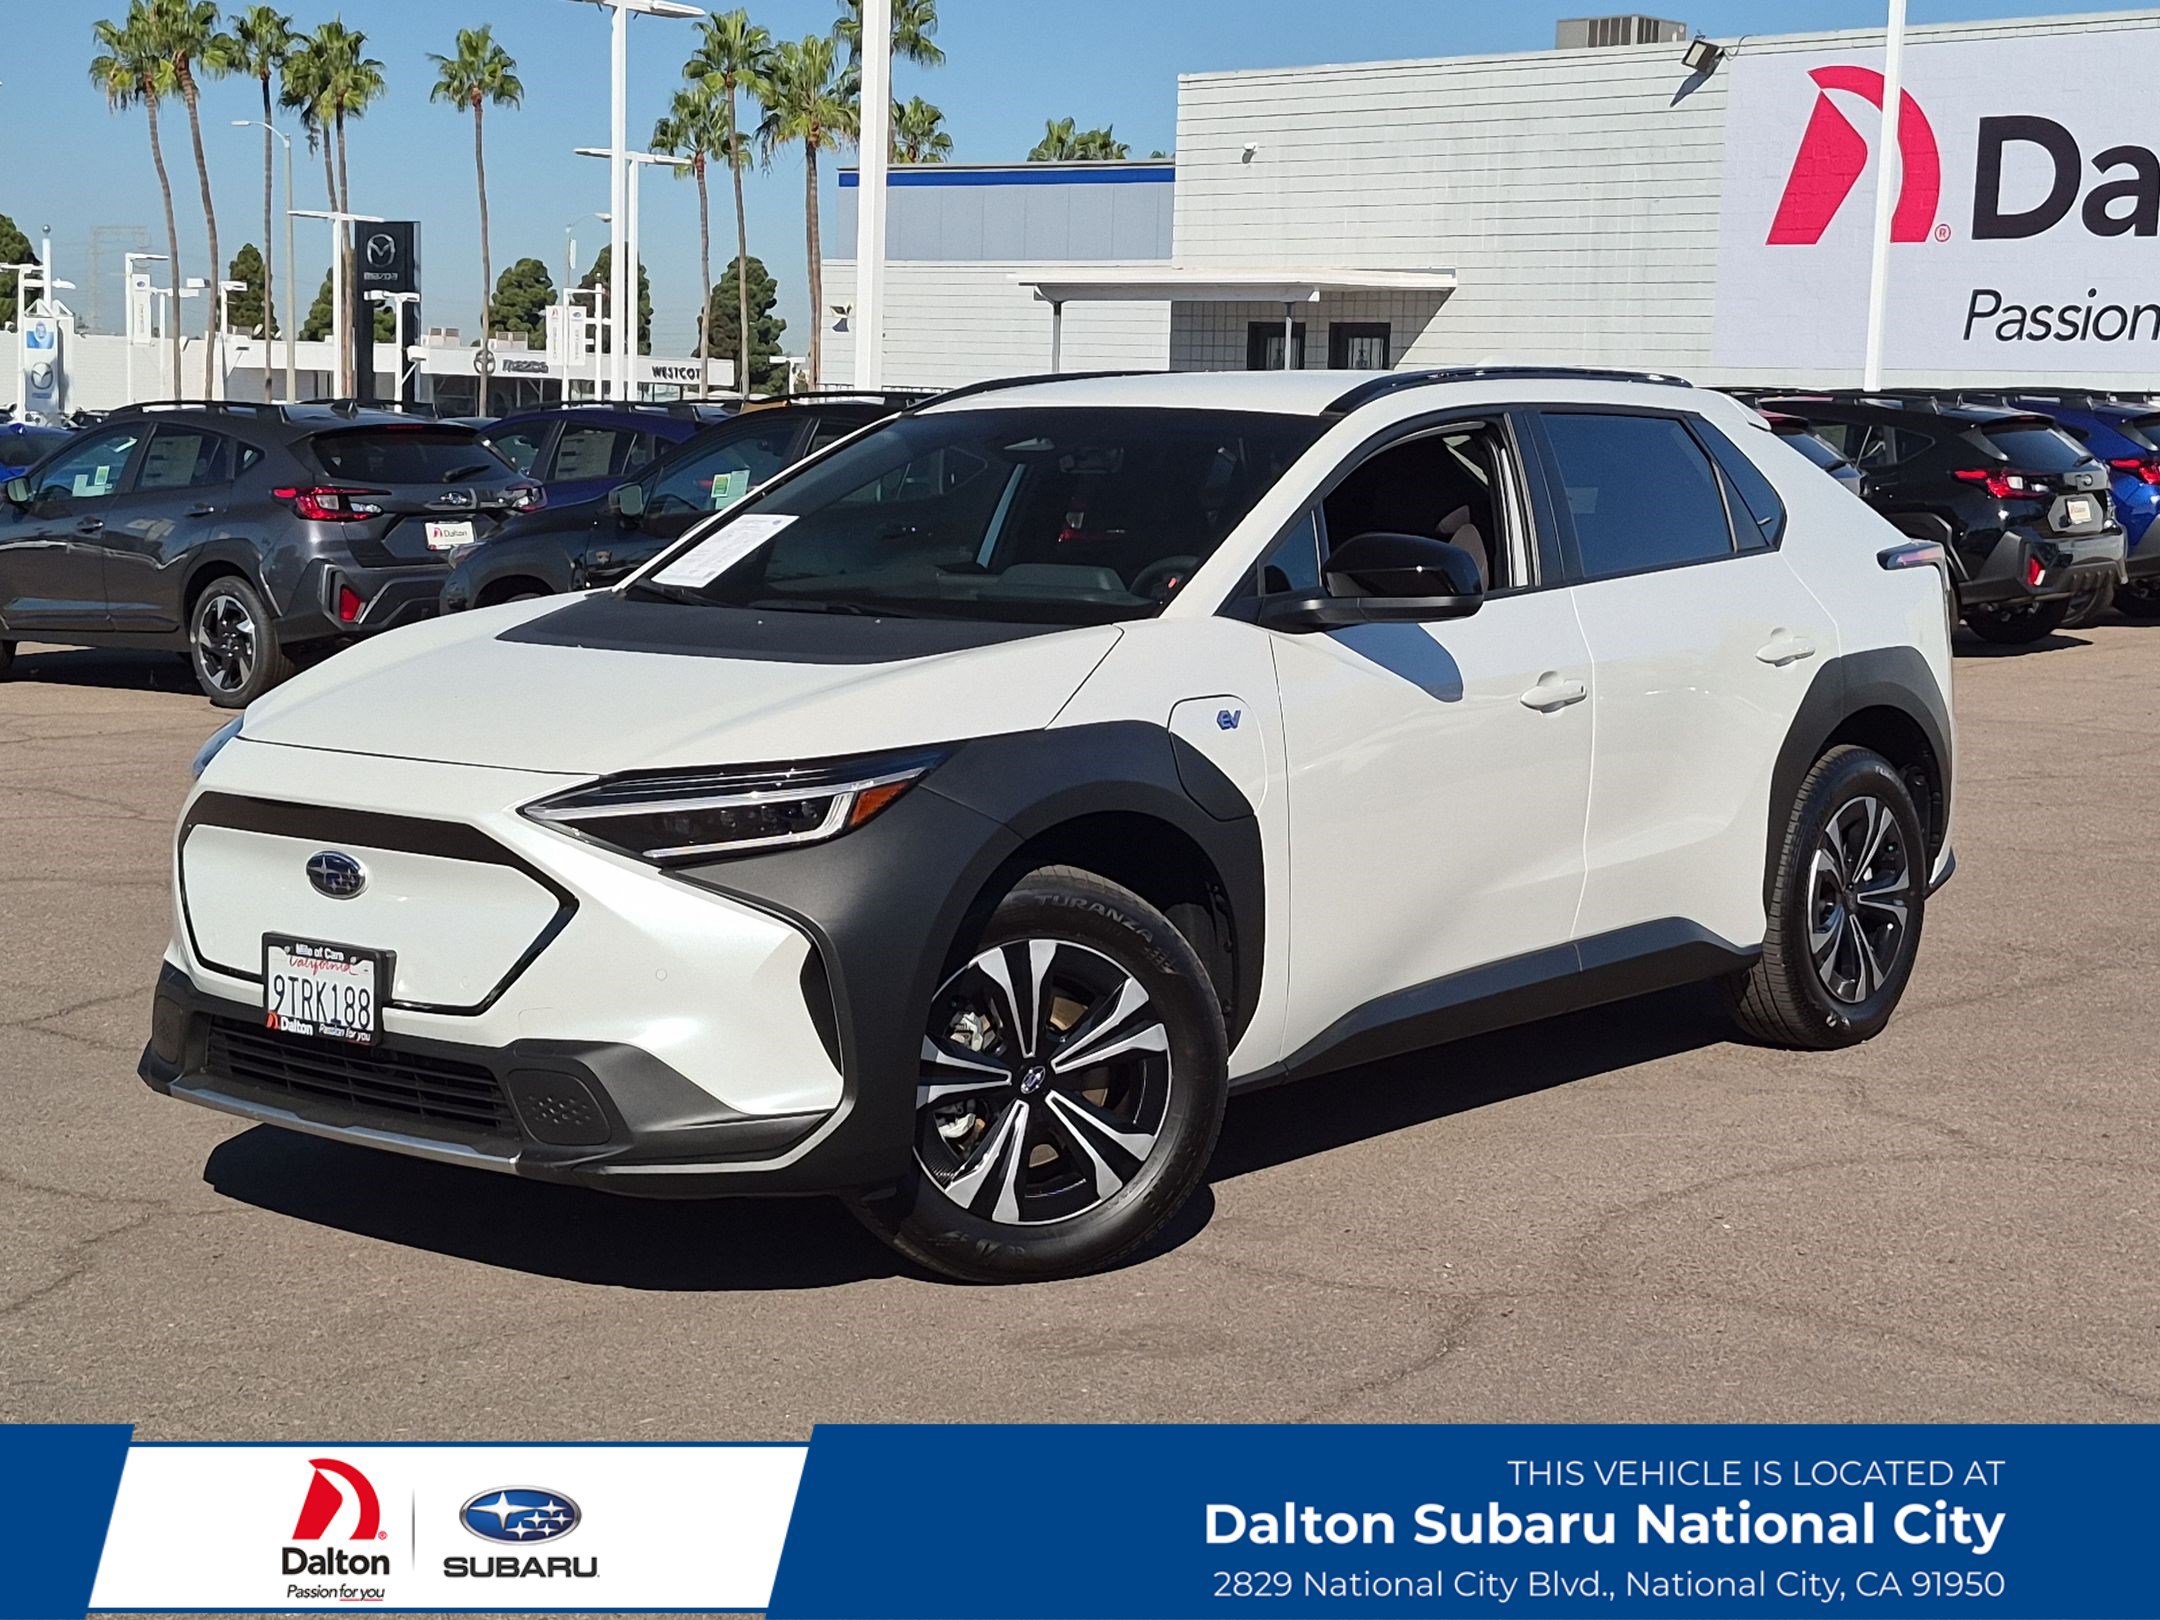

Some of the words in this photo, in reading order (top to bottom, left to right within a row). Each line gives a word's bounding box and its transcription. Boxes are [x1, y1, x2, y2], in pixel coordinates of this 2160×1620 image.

[1972, 114, 2160, 240] Da
[1963, 288, 2160, 341] Passion
[1034, 895, 1153, 943] TURANZA
[314, 947, 323, 957] of
[274, 974, 370, 1029] 9TRK188
[281, 1016, 313, 1036] Dalton
[357, 1032, 371, 1042] you
